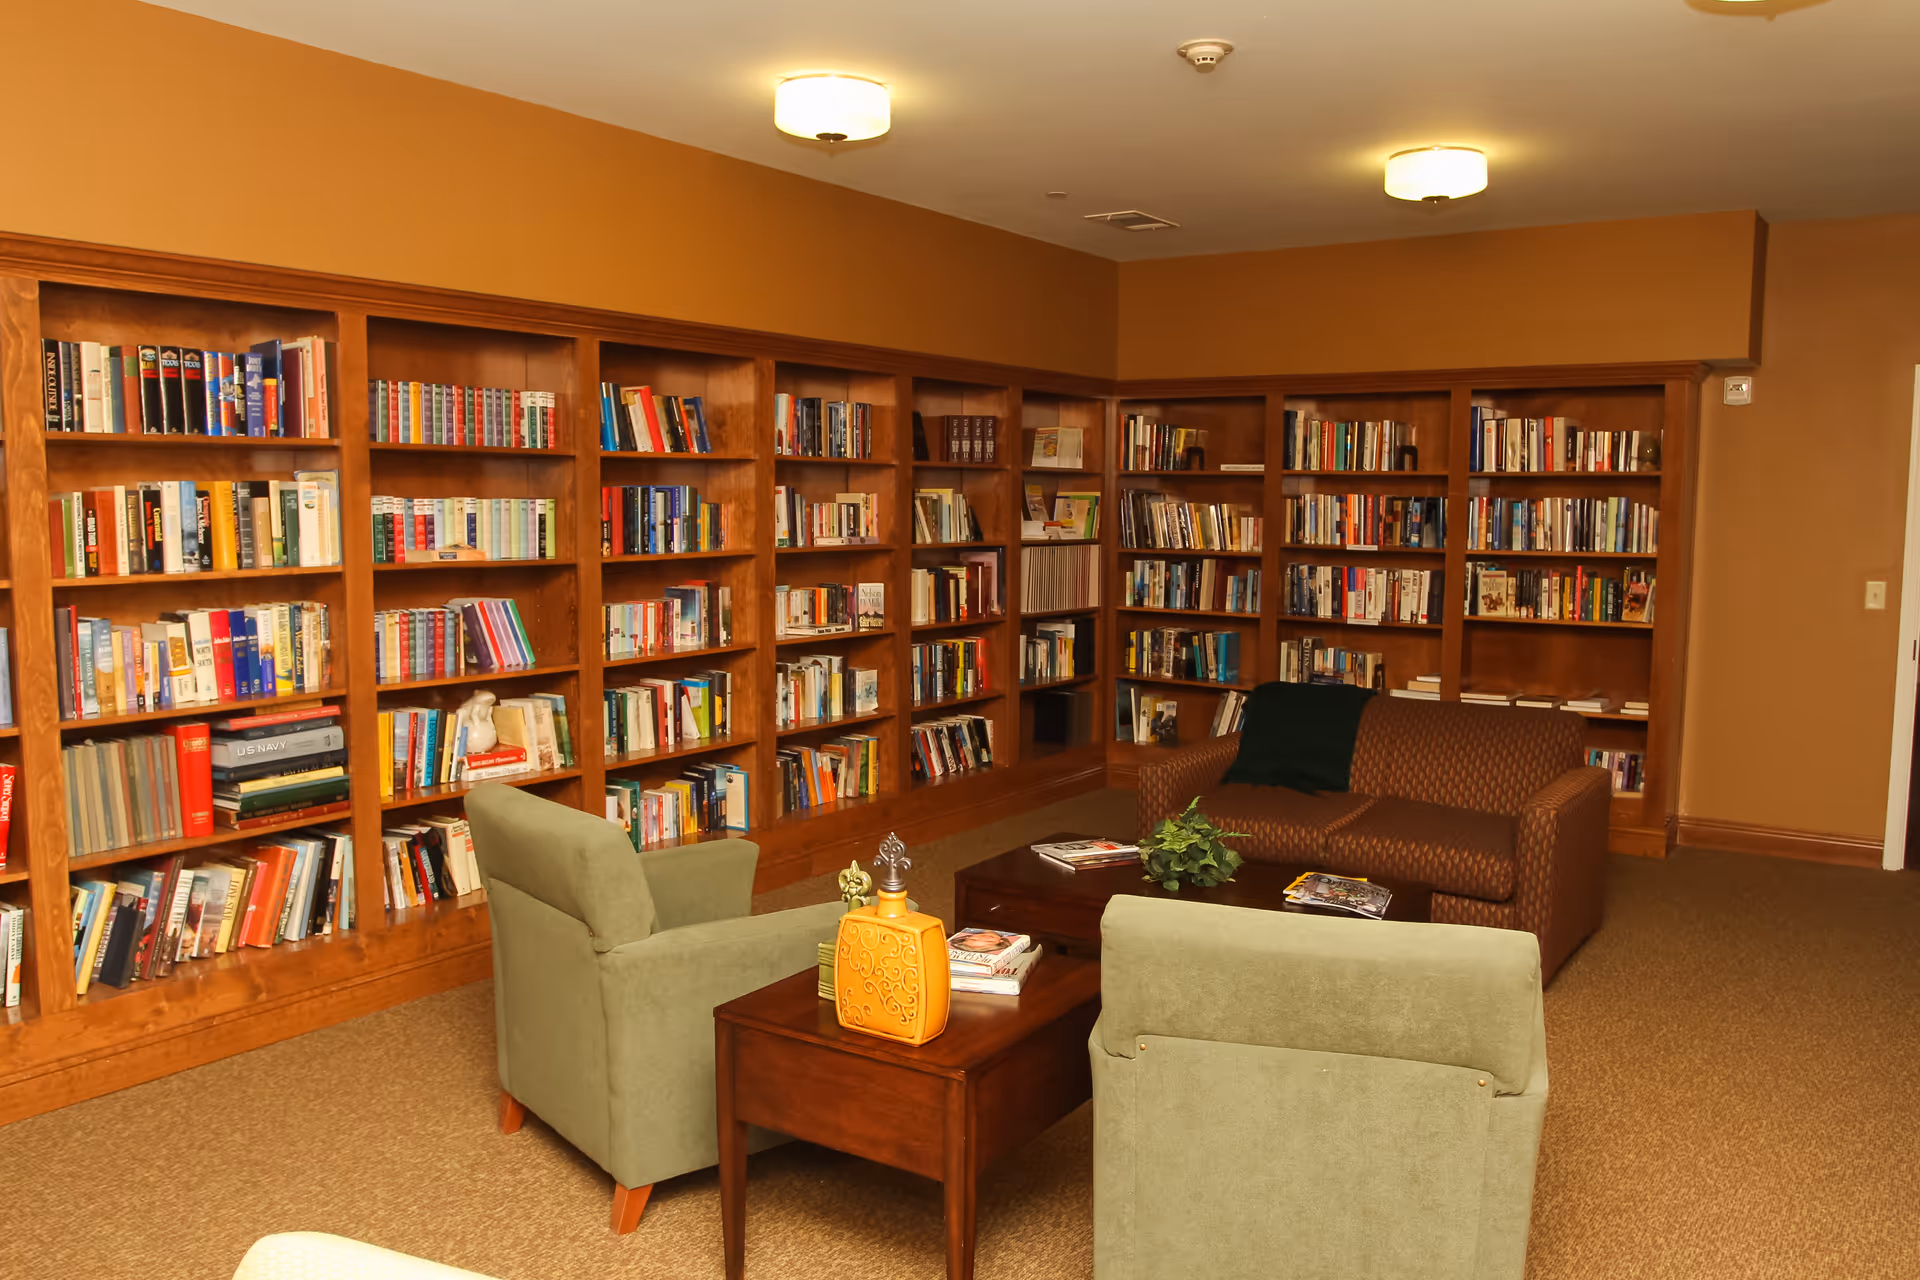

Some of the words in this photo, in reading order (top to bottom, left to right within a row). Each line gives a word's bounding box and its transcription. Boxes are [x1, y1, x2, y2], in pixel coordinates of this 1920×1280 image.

[46, 352, 56, 376] INSIDE
[162, 359, 180, 367] TEXAS
[184, 360, 201, 369] TEXAS
[48, 377, 58, 411] OUTSIDE
[87, 517, 96, 532] BRAD
[153, 508, 163, 542] Centennial
[197, 519, 206, 544] Michener
[88, 532, 97, 546] THOR
[860, 587, 881, 598] Nelson
[295, 630, 304, 646] West
[296, 656, 304, 675] Eden
[237, 745, 256, 756] US
[257, 740, 288, 753] NAVY
[227, 880, 240, 899] LONE
[222, 902, 234, 921] STAR
[104, 920, 113, 935] THE
[93, 936, 110, 968] LEOPARD
